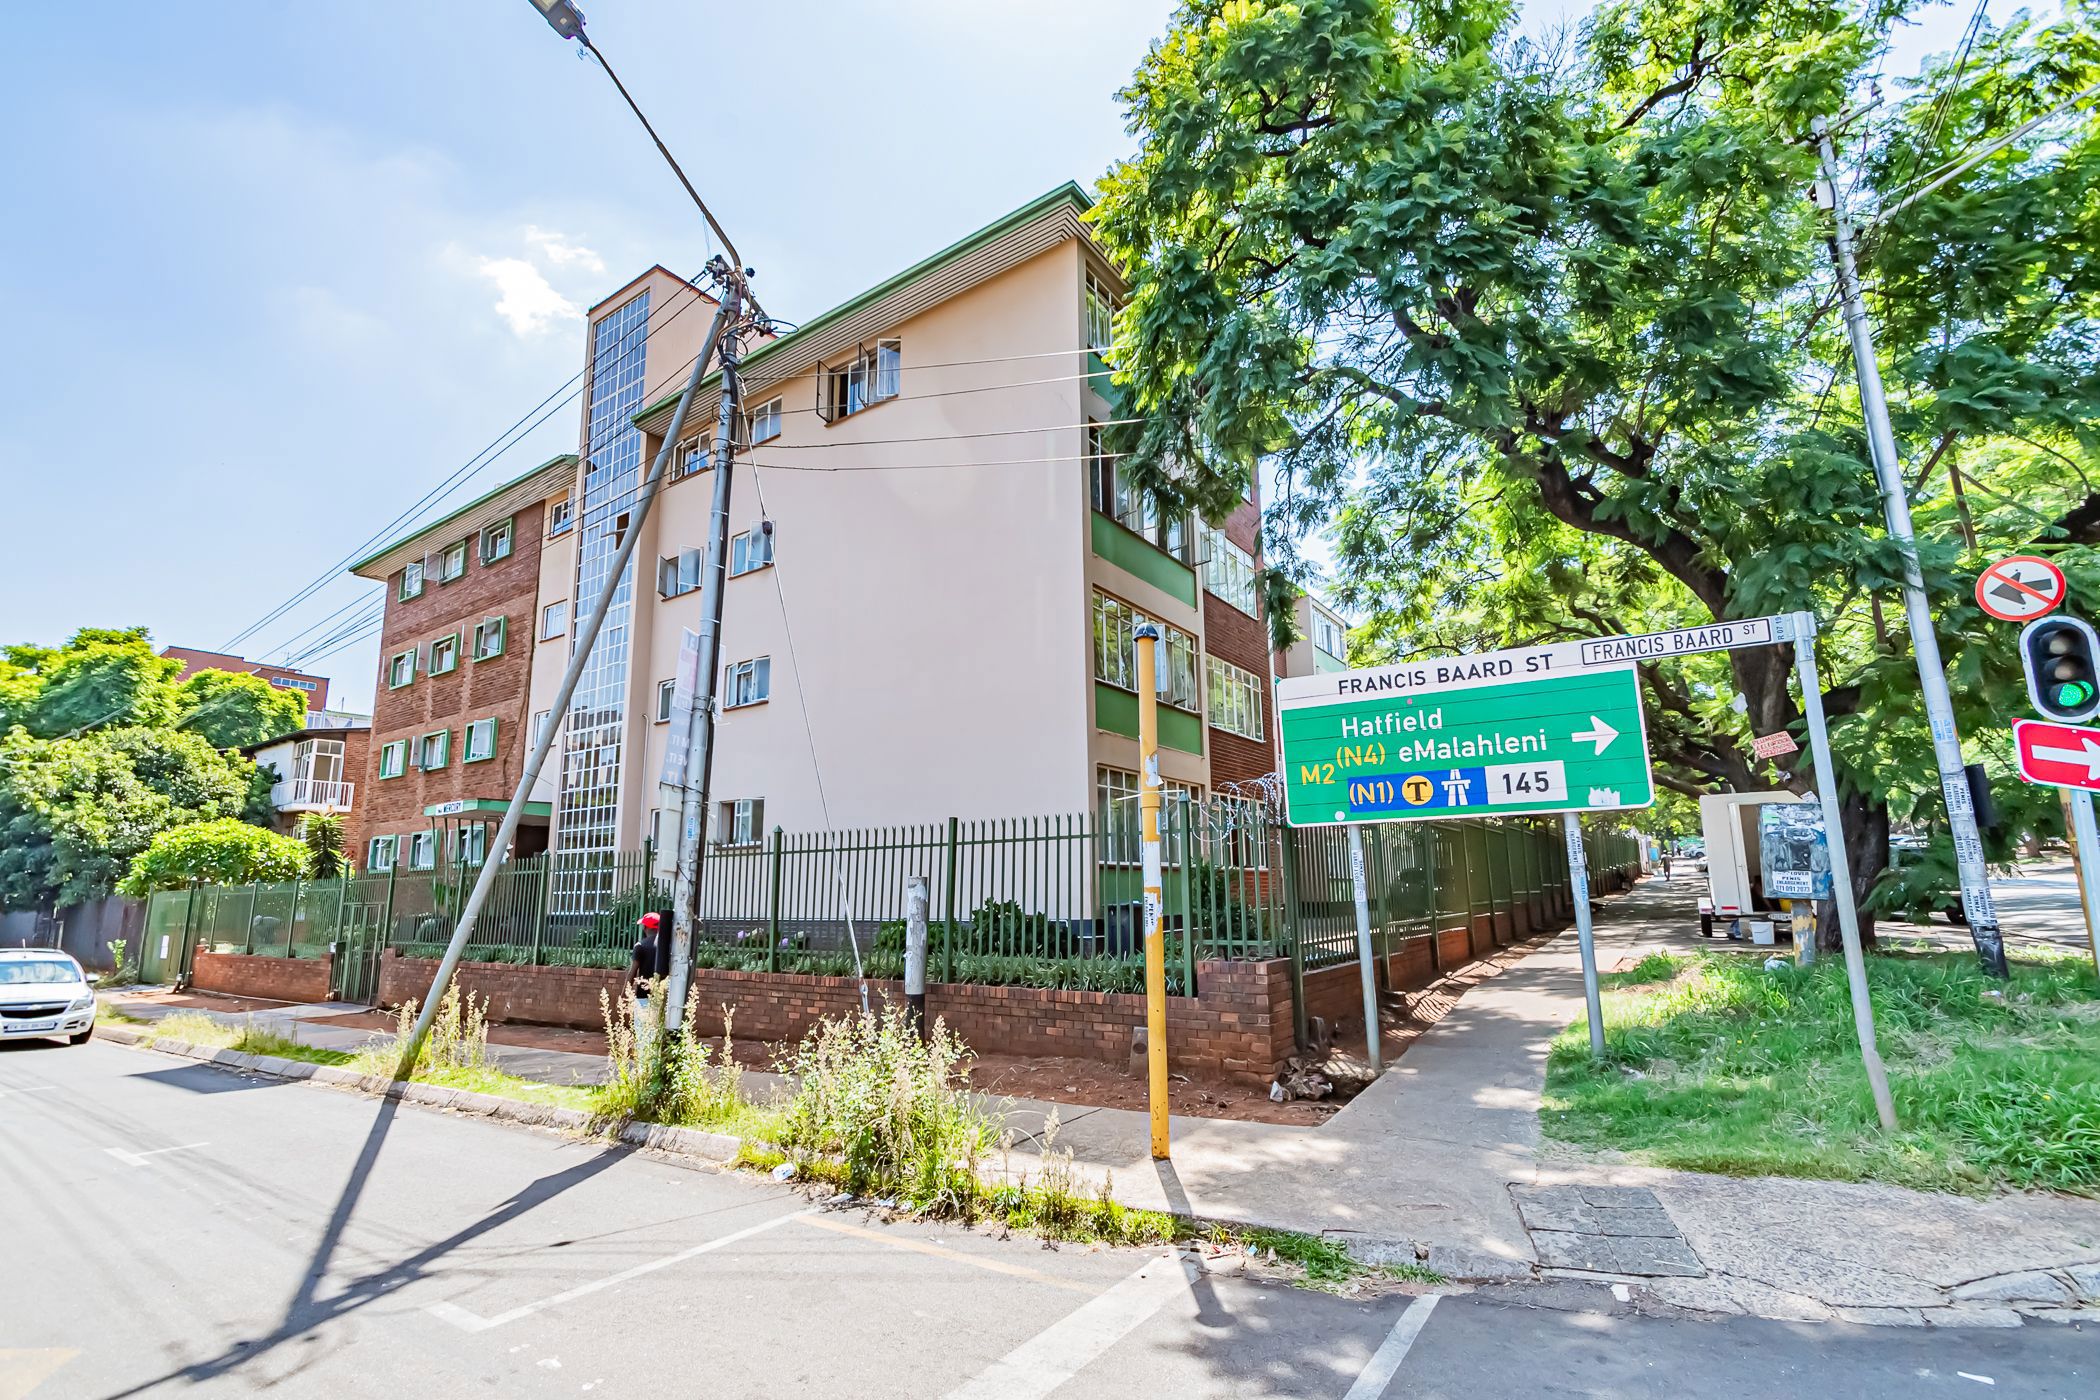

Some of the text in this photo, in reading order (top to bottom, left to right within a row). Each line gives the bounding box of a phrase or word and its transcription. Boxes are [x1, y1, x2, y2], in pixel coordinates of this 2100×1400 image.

[1593, 624, 1756, 661] FRANCIS BAARD ST
[1338, 653, 1553, 695] FRANCIS BAARD ST
[1341, 708, 1443, 739] Hatfield
[1336, 729, 1547, 769] (N4) eMalahleni
[1300, 763, 1335, 786] M2
[1349, 771, 1550, 806] (N1) T 145
